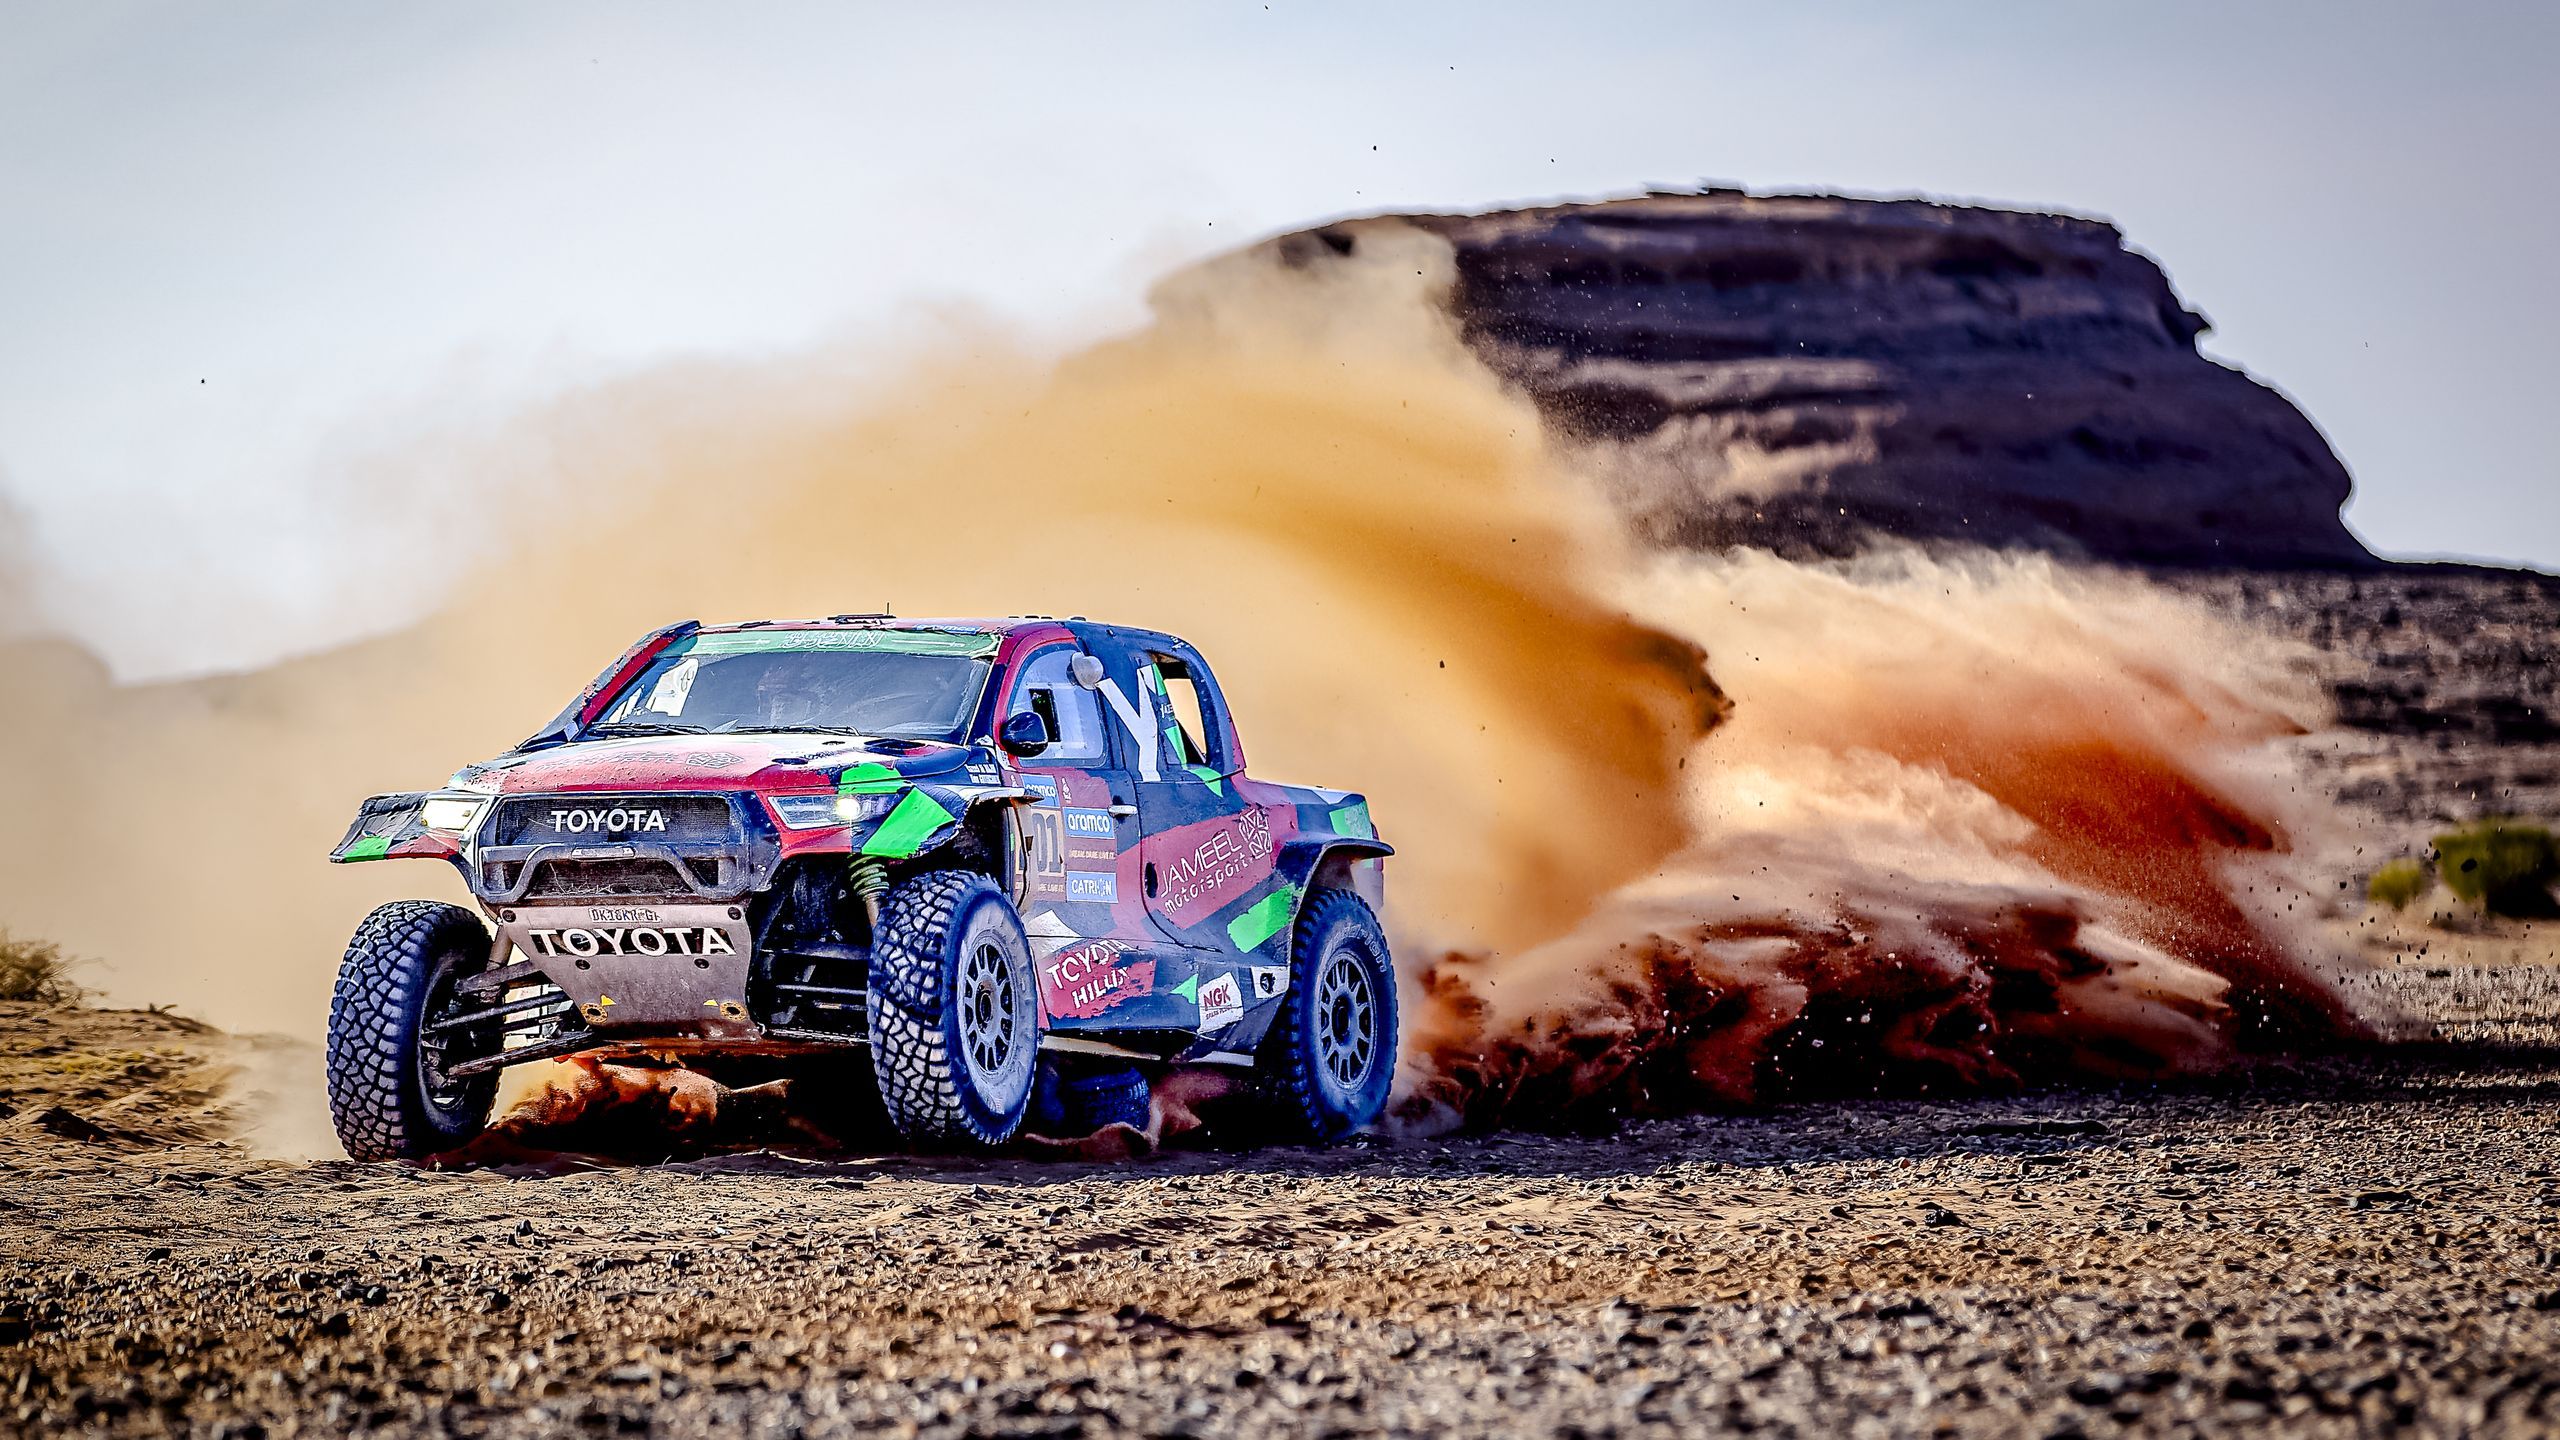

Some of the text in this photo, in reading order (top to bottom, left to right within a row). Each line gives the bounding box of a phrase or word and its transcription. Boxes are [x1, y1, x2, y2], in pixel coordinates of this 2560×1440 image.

[551, 808, 666, 833] TOYOTA
[1068, 813, 1110, 832] aramco
[1019, 813, 1061, 872] 01
[1160, 830, 1242, 898] JAMEEL
[528, 927, 737, 957] TOYOTA
[1203, 983, 1231, 1011] NGK
